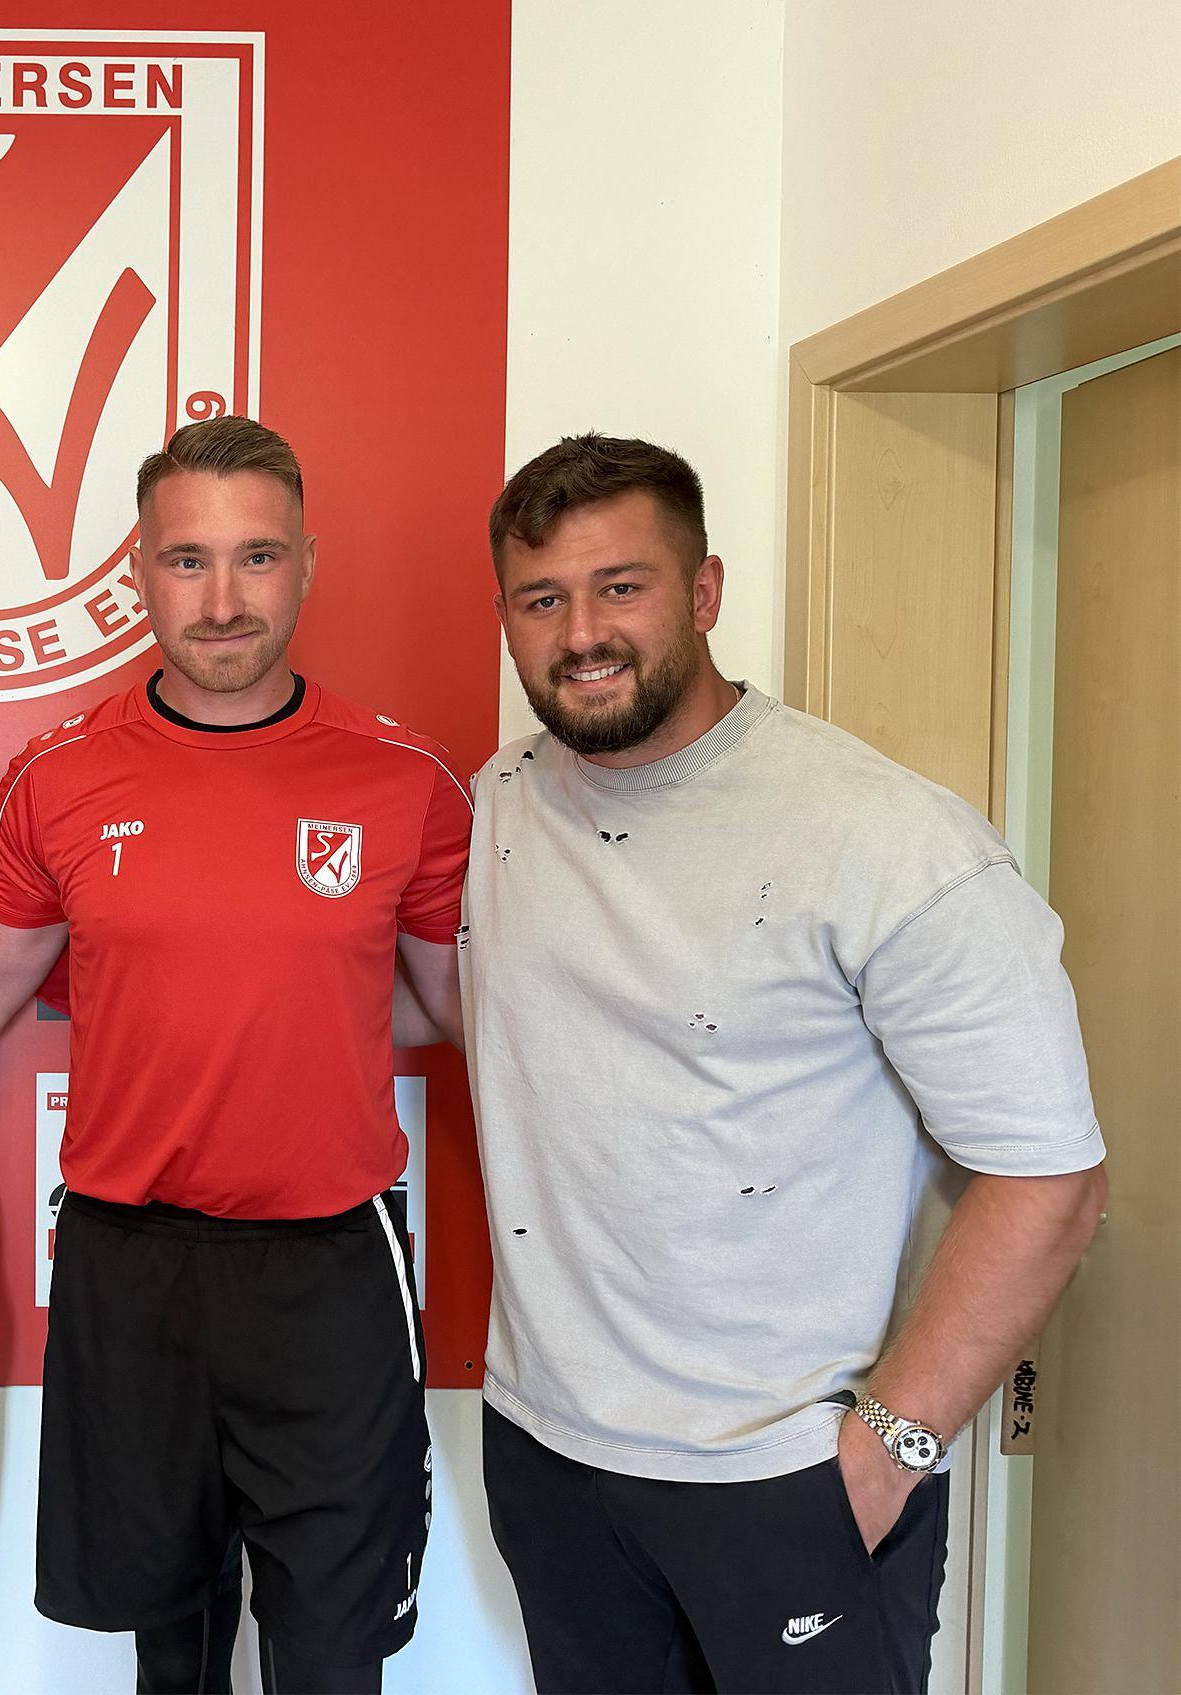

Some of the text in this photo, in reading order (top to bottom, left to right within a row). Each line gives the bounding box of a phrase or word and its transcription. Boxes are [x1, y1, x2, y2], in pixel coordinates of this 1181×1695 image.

[100, 820, 144, 840] JAKO
[307, 824, 353, 834] MEINERSEN
[111, 842, 123, 877] 1
[788, 1612, 825, 1634] NIKE
